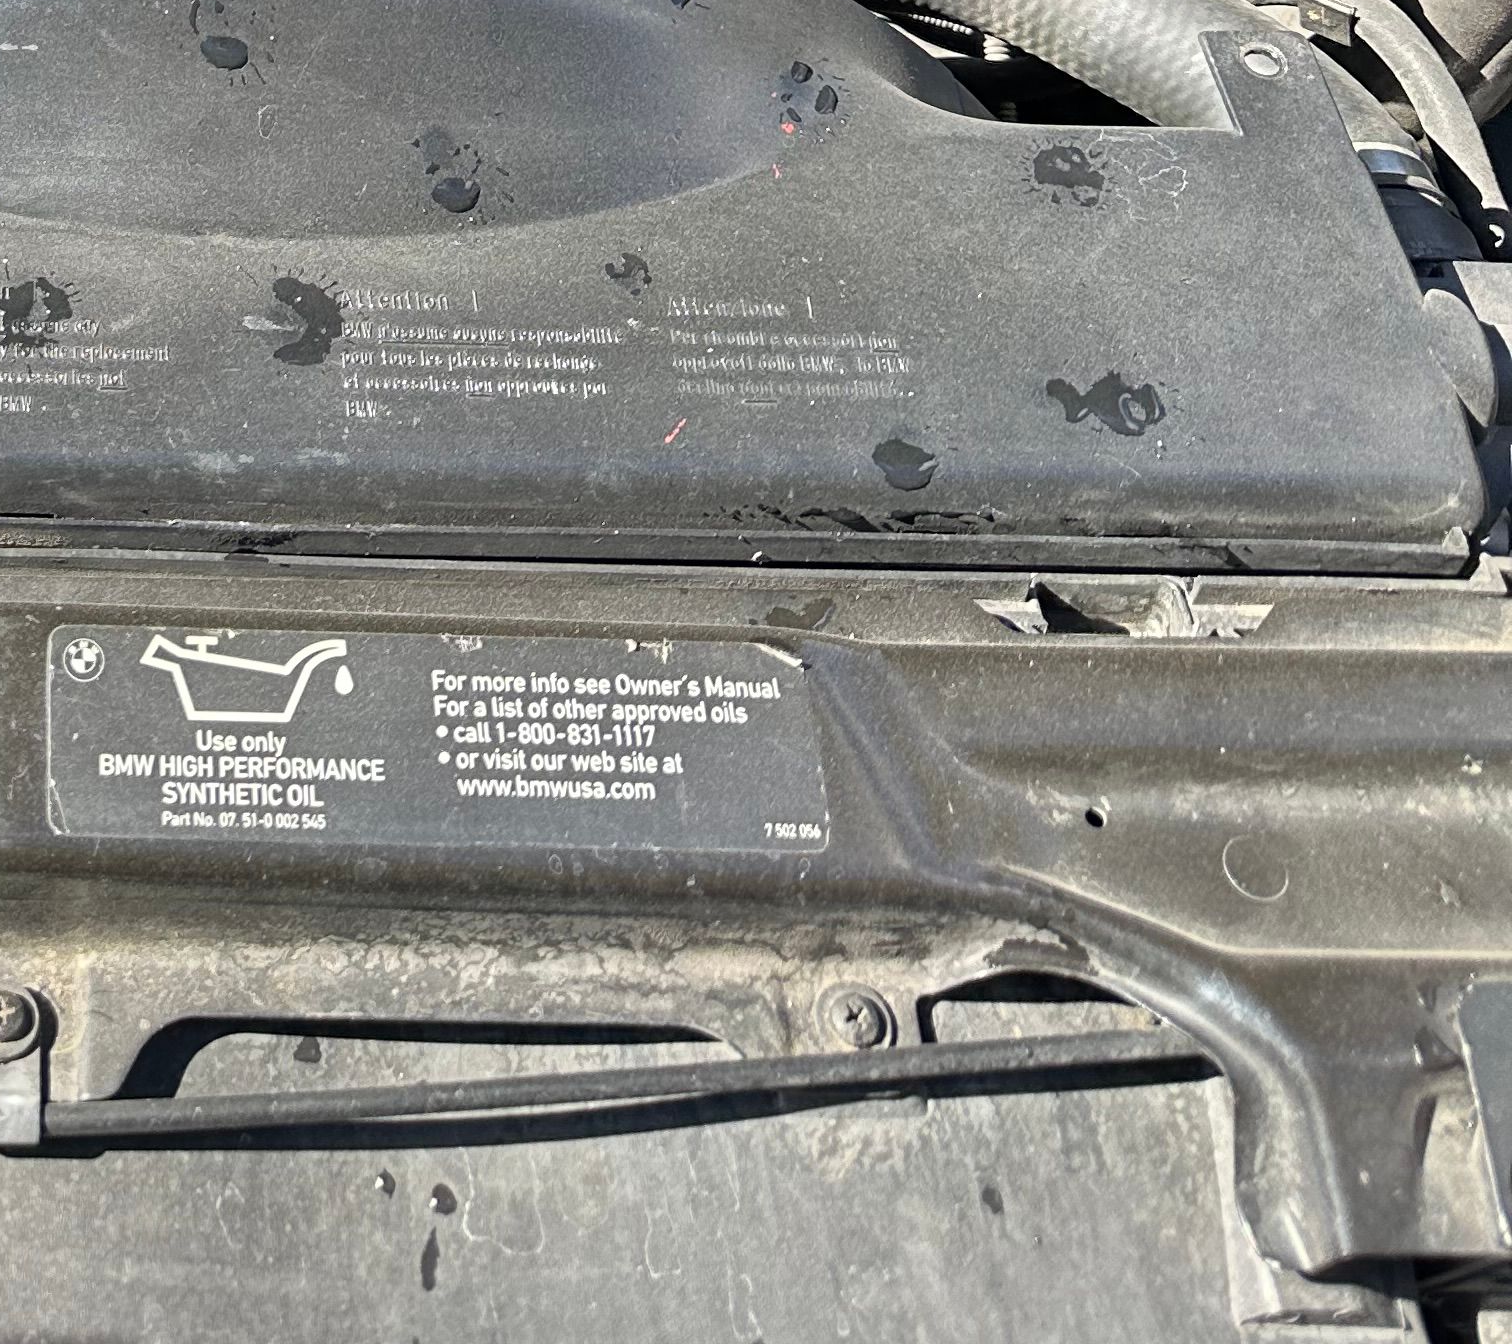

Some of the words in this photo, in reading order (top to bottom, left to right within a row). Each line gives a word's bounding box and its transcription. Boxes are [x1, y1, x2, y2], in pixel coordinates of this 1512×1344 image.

[340, 289, 449, 310] Attention
[431, 669, 468, 693] For
[472, 675, 527, 694] more
[530, 671, 570, 695] info
[573, 677, 611, 696] see
[615, 673, 701, 698] Owner's
[705, 676, 781, 700] Manual
[434, 694, 469, 718] For
[473, 700, 488, 719] a
[492, 696, 525, 720] list
[527, 696, 549, 720] of
[552, 698, 608, 721] other
[611, 698, 707, 729] approved
[710, 701, 748, 725] oils
[196, 730, 237, 752] Use
[241, 730, 286, 758] only
[453, 723, 492, 745] call
[495, 722, 656, 747] 1-800-831-1117
[99, 753, 155, 776] BMW
[159, 754, 214, 778] HIGH
[219, 755, 386, 782] PERFORMANCE
[455, 751, 481, 770] or
[483, 748, 527, 771] visit
[531, 753, 567, 772] our
[571, 749, 616, 773] web
[620, 750, 658, 774] site
[662, 753, 684, 775] at
[162, 782, 283, 806] SYNTHETIC
[287, 784, 325, 808] OIL
[457, 775, 657, 801] www.bmwusa.com
[162, 811, 191, 827] Part
[193, 812, 216, 828] No.
[275, 813, 300, 829] 002
[764, 823, 773, 837] 7
[774, 823, 797, 838] 502
[799, 823, 822, 839] 056
